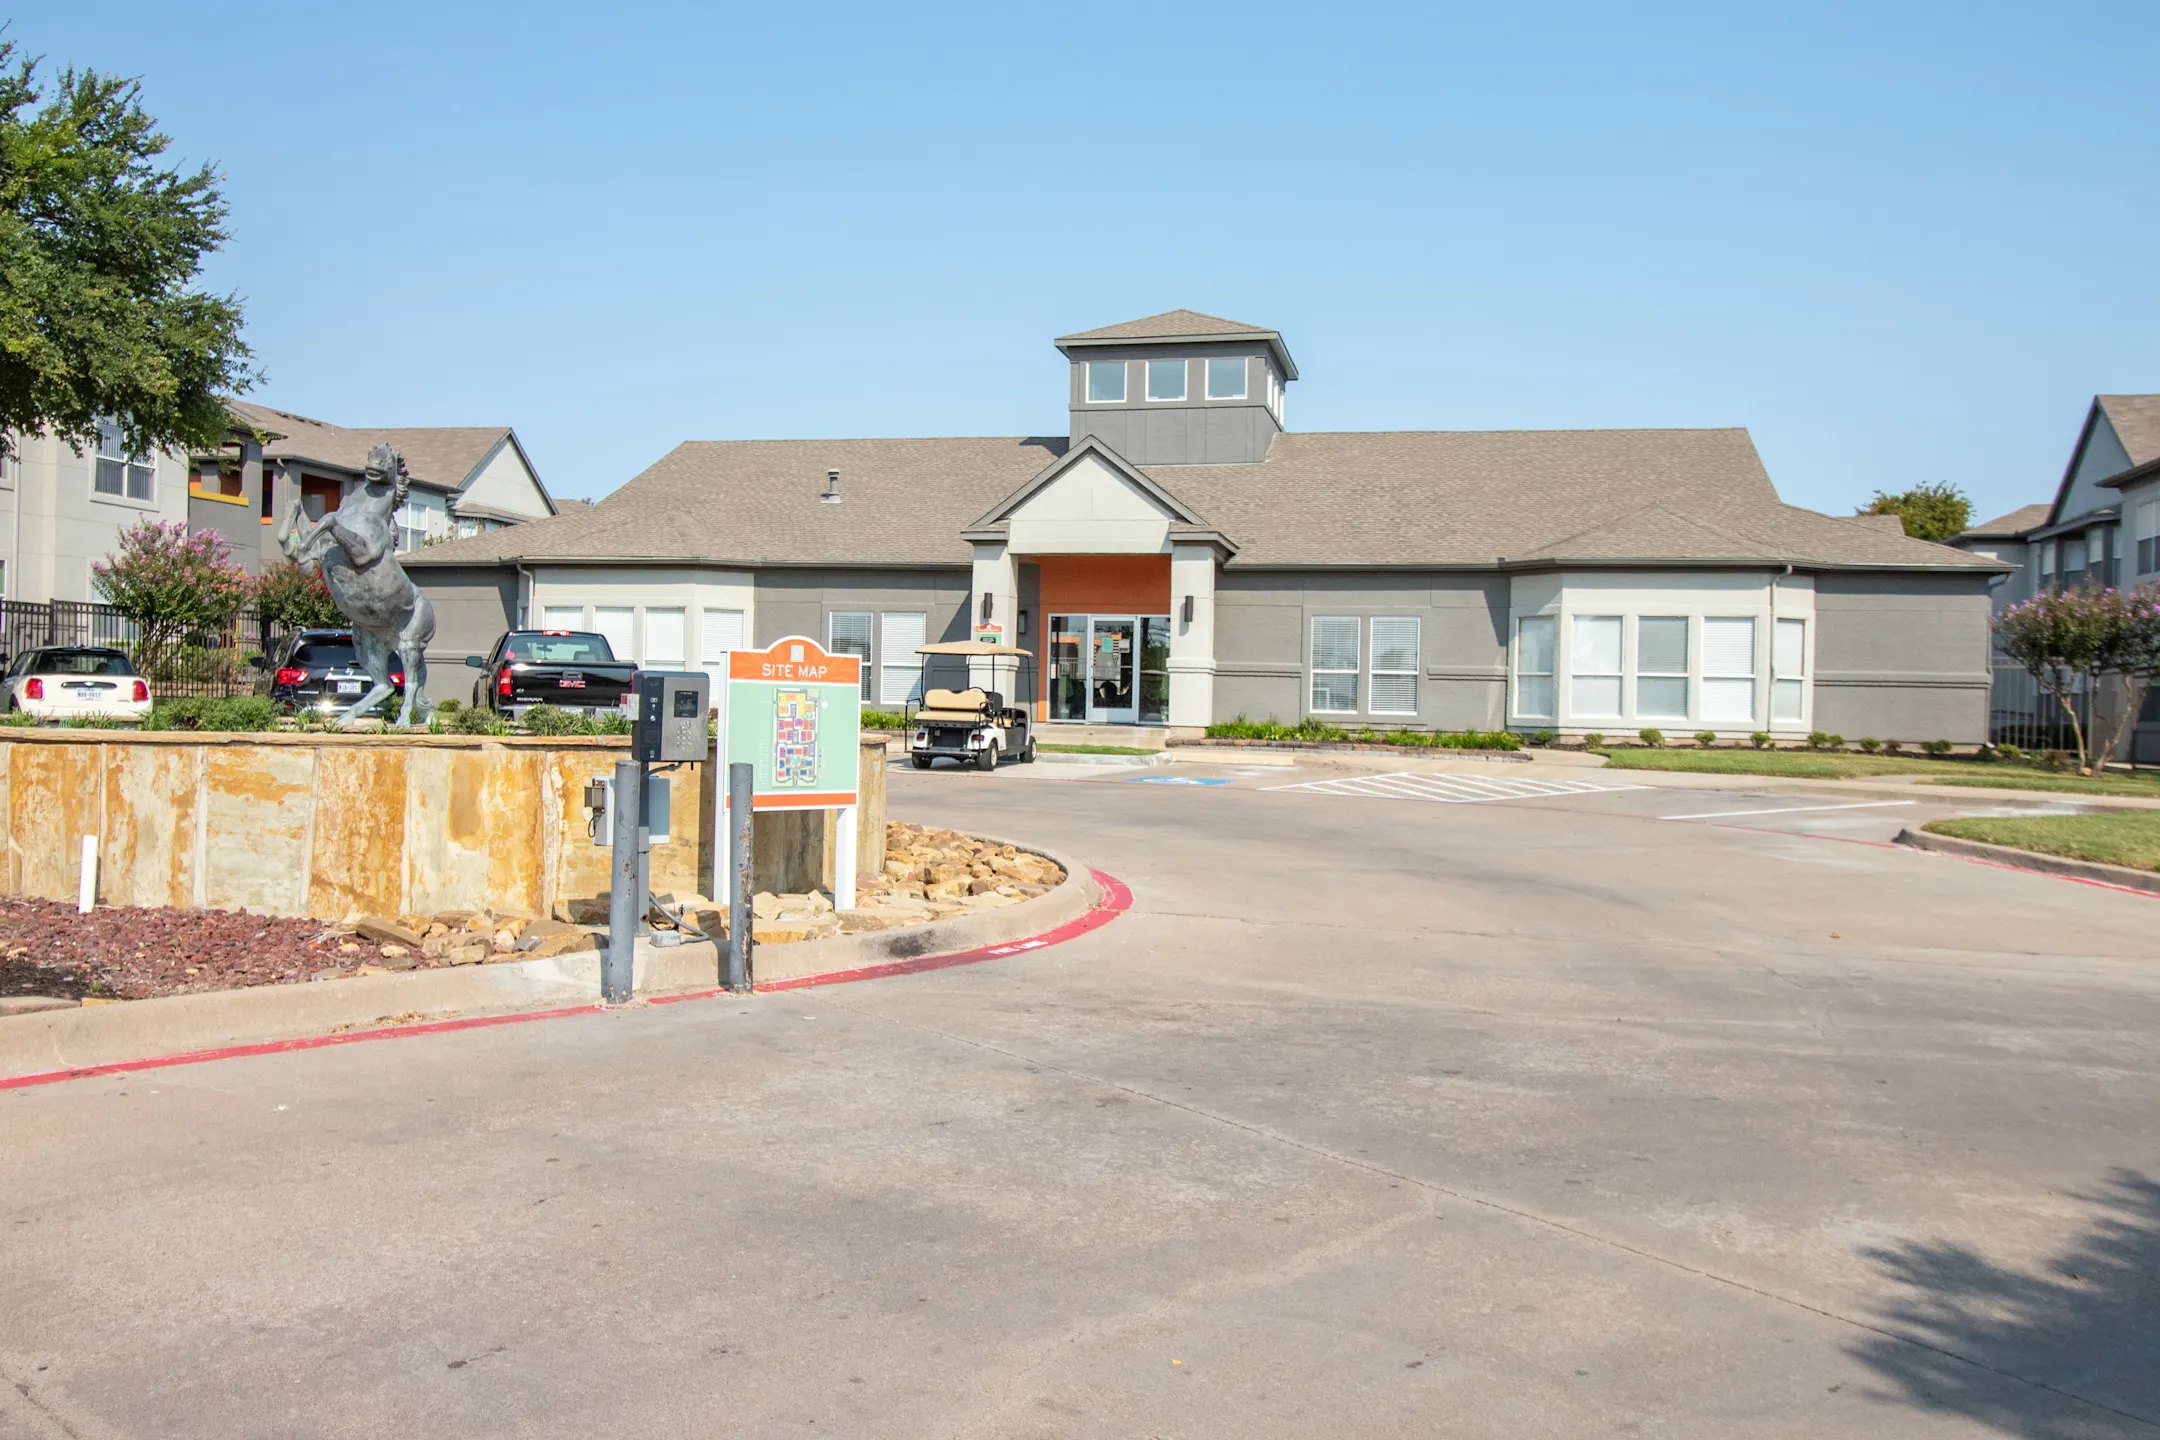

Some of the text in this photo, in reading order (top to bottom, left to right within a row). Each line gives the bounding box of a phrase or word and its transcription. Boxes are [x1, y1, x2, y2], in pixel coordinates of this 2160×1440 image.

[762, 663, 827, 678] SITE MAP
[559, 680, 587, 688] GMC
